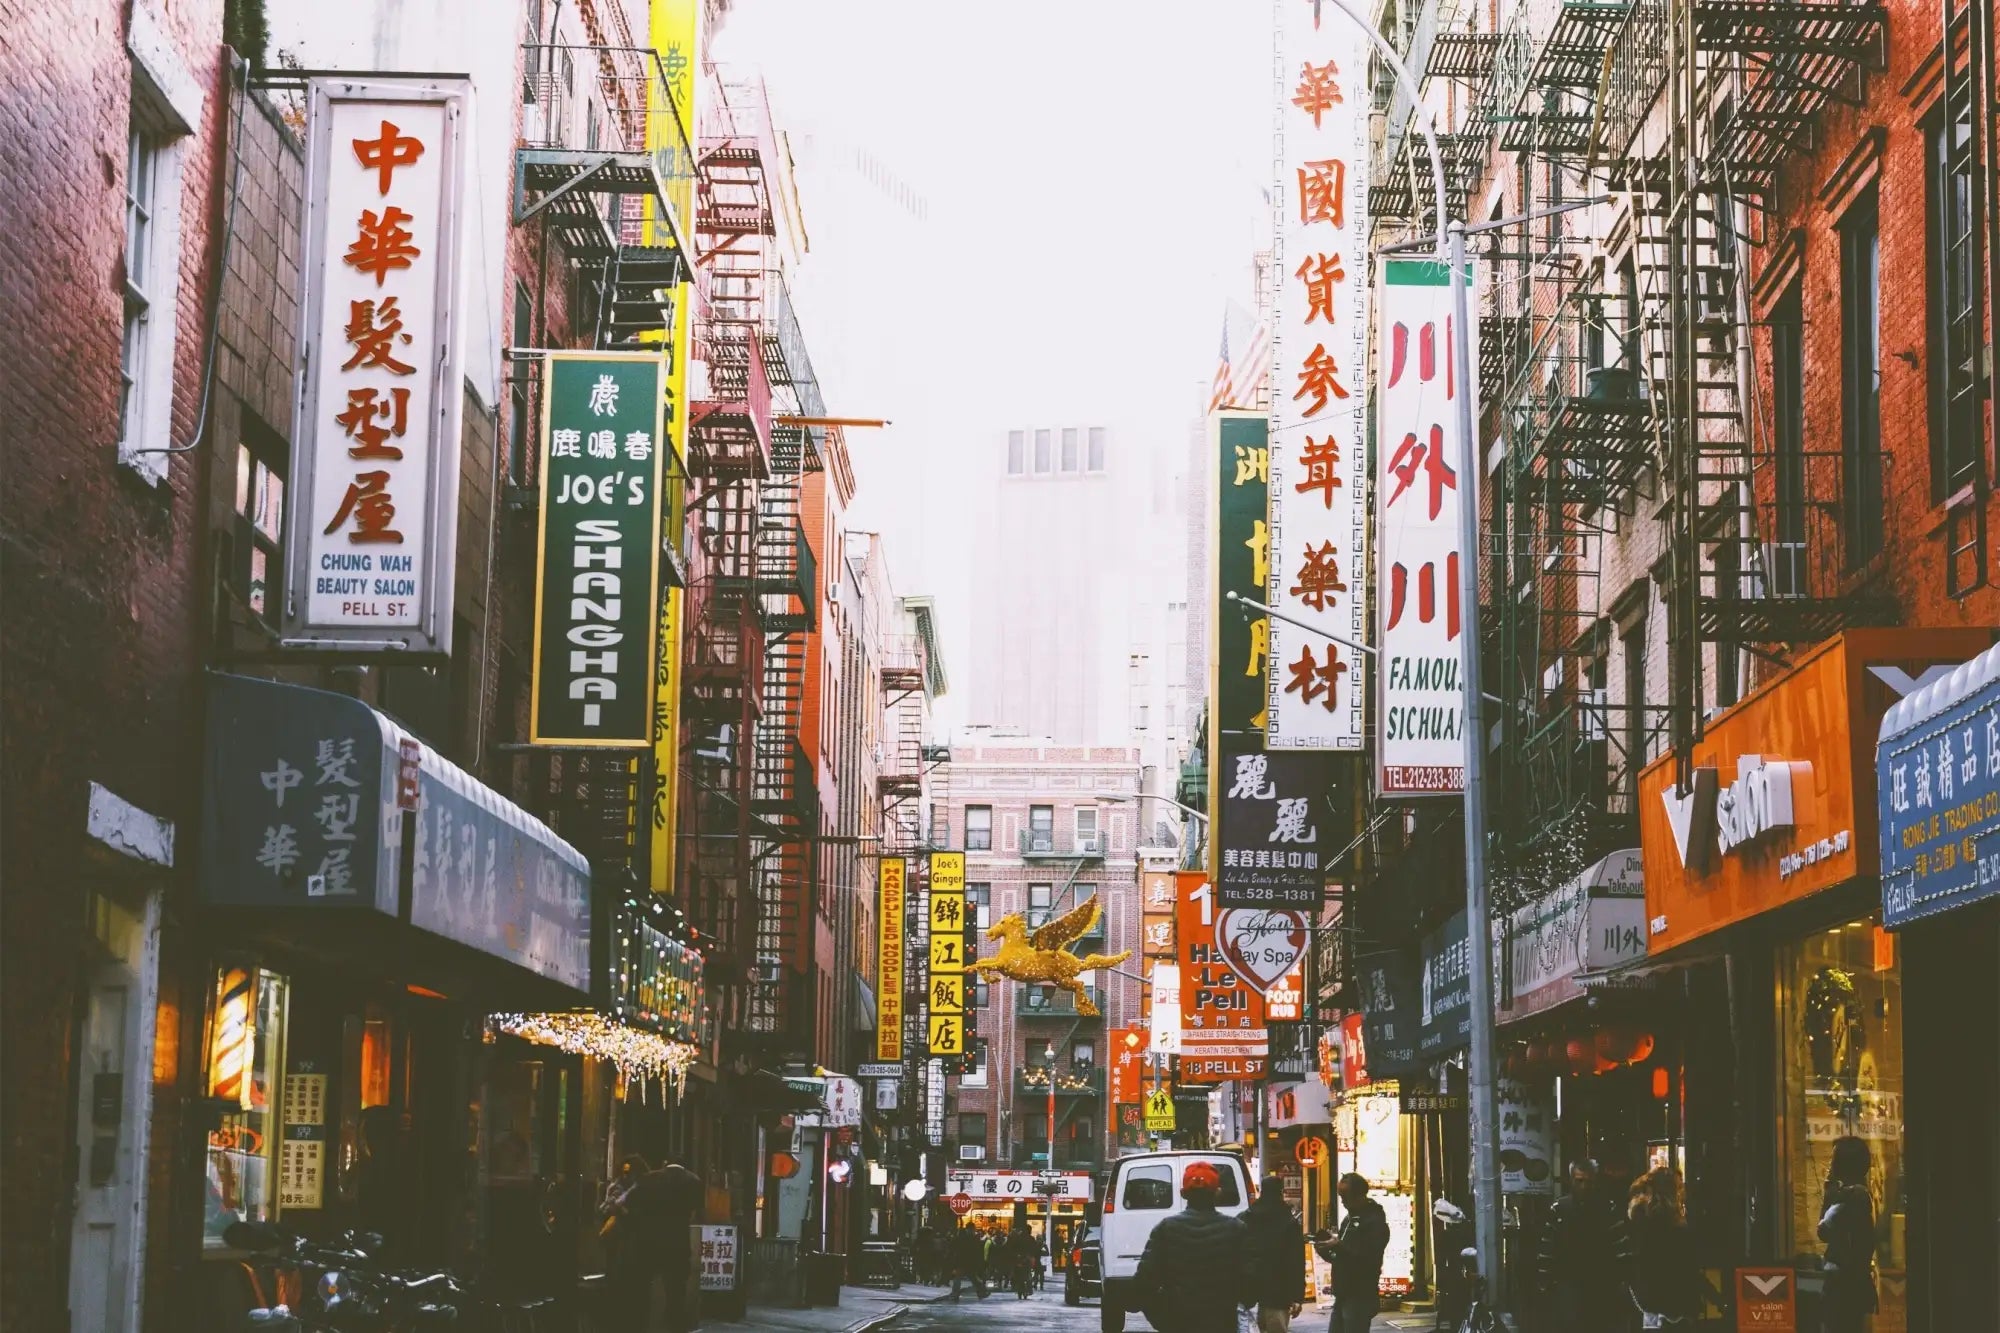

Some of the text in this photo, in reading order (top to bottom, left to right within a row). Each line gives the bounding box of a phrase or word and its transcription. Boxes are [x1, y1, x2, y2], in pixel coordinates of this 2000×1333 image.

[323, 119, 426, 545] 中華髮型屋
[551, 429, 653, 461] 鹿鳴春
[556, 472, 645, 506] JOE'S
[321, 553, 412, 572] CHUNG WAH
[316, 577, 415, 597] BEAUTY SALON
[342, 601, 408, 617] PELL ST.
[565, 519, 624, 727] SHANGHAI
[1389, 656, 1463, 692] FAMOU
[1387, 766, 1464, 788] TEL:212-233-388
[1903, 820, 1925, 850] RONG
[1928, 813, 1940, 840] JIE
[1944, 798, 1983, 834] TRADING
[937, 857, 959, 869] Joe's
[1224, 849, 1318, 870] 美容美髮中心
[932, 872, 963, 886] Ginger
[1620, 868, 1626, 879] &
[1263, 947, 1294, 966] Spa
[882, 943, 899, 994] NOODLES
[931, 896, 963, 1051] 錦江飯店
[1200, 967, 1237, 989] Le
[1195, 989, 1249, 1011] Pell
[1266, 990, 1301, 1003] FOOT
[1270, 1004, 1296, 1018] RUB
[1194, 1046, 1254, 1054] KERATIN TREATMENT
[1204, 1060, 1241, 1074] PELL
[1245, 1060, 1264, 1073] ST
[1149, 1118, 1173, 1128] AHEAD
[952, 1198, 971, 1208] STOP
[1760, 1303, 1783, 1311] salon
